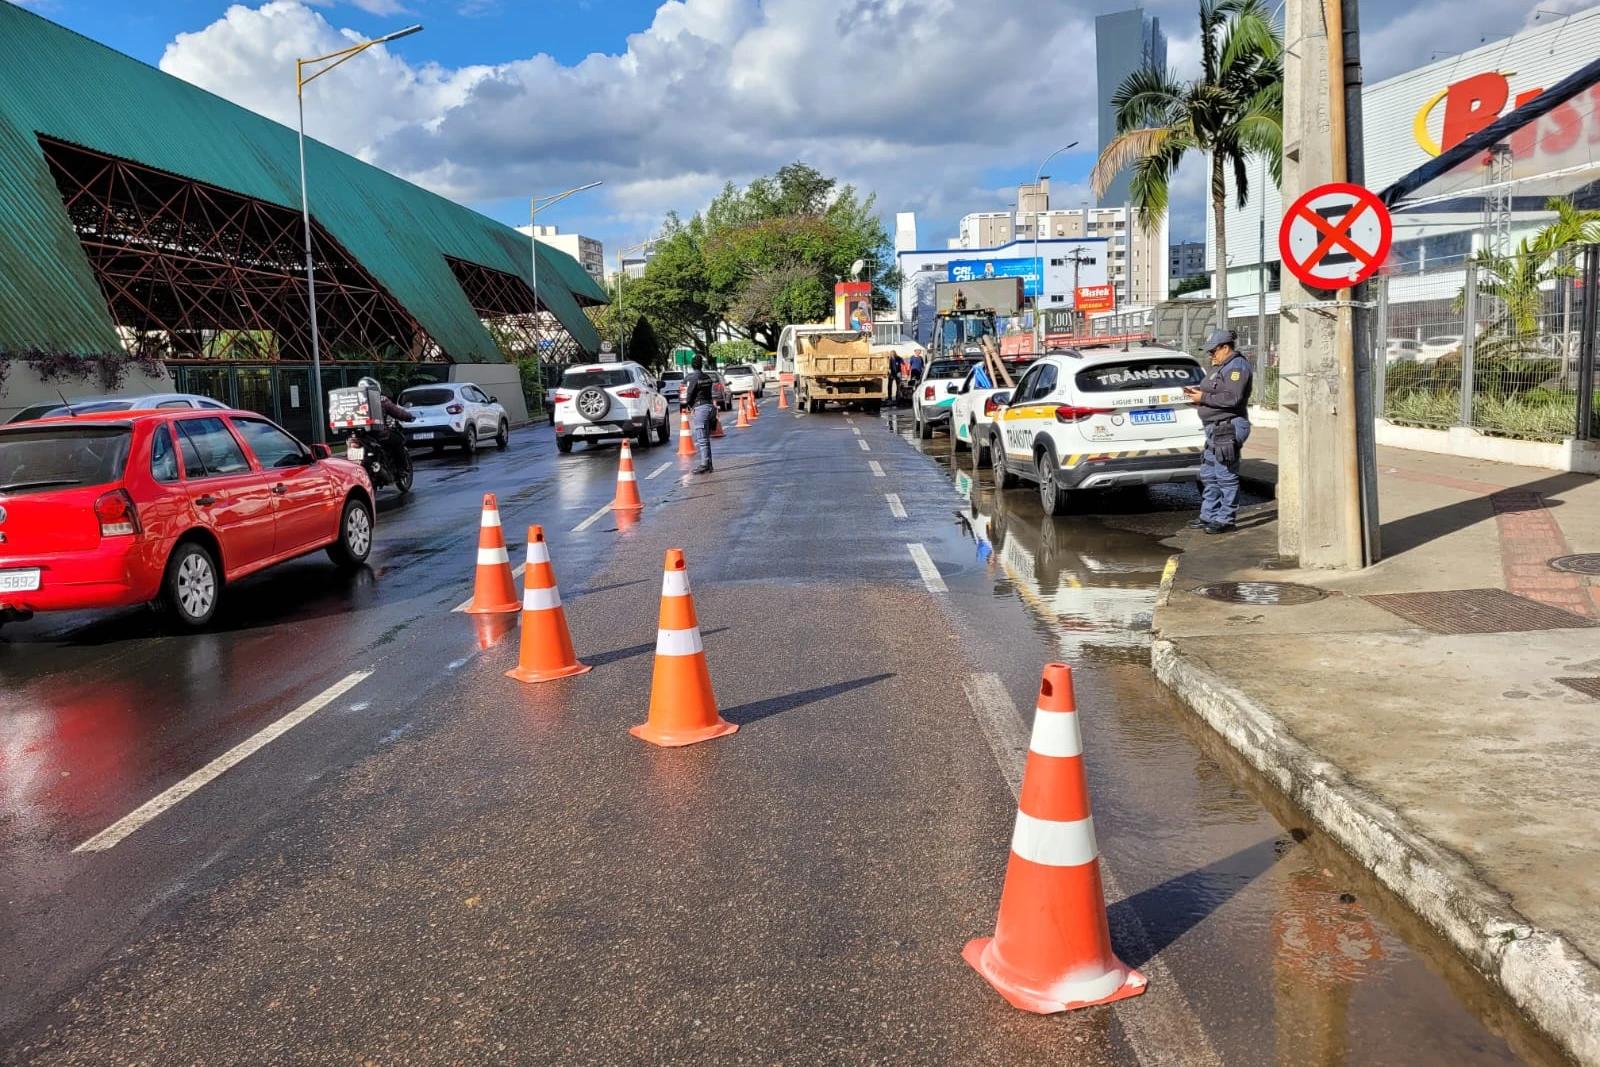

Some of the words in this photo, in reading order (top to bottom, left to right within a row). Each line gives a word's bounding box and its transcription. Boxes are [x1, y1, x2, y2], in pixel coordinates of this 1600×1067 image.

[1080, 287, 1110, 297] Bistek
[1097, 369, 1190, 385] TRÂNSITO
[1006, 426, 1034, 450] TRÂNSITO
